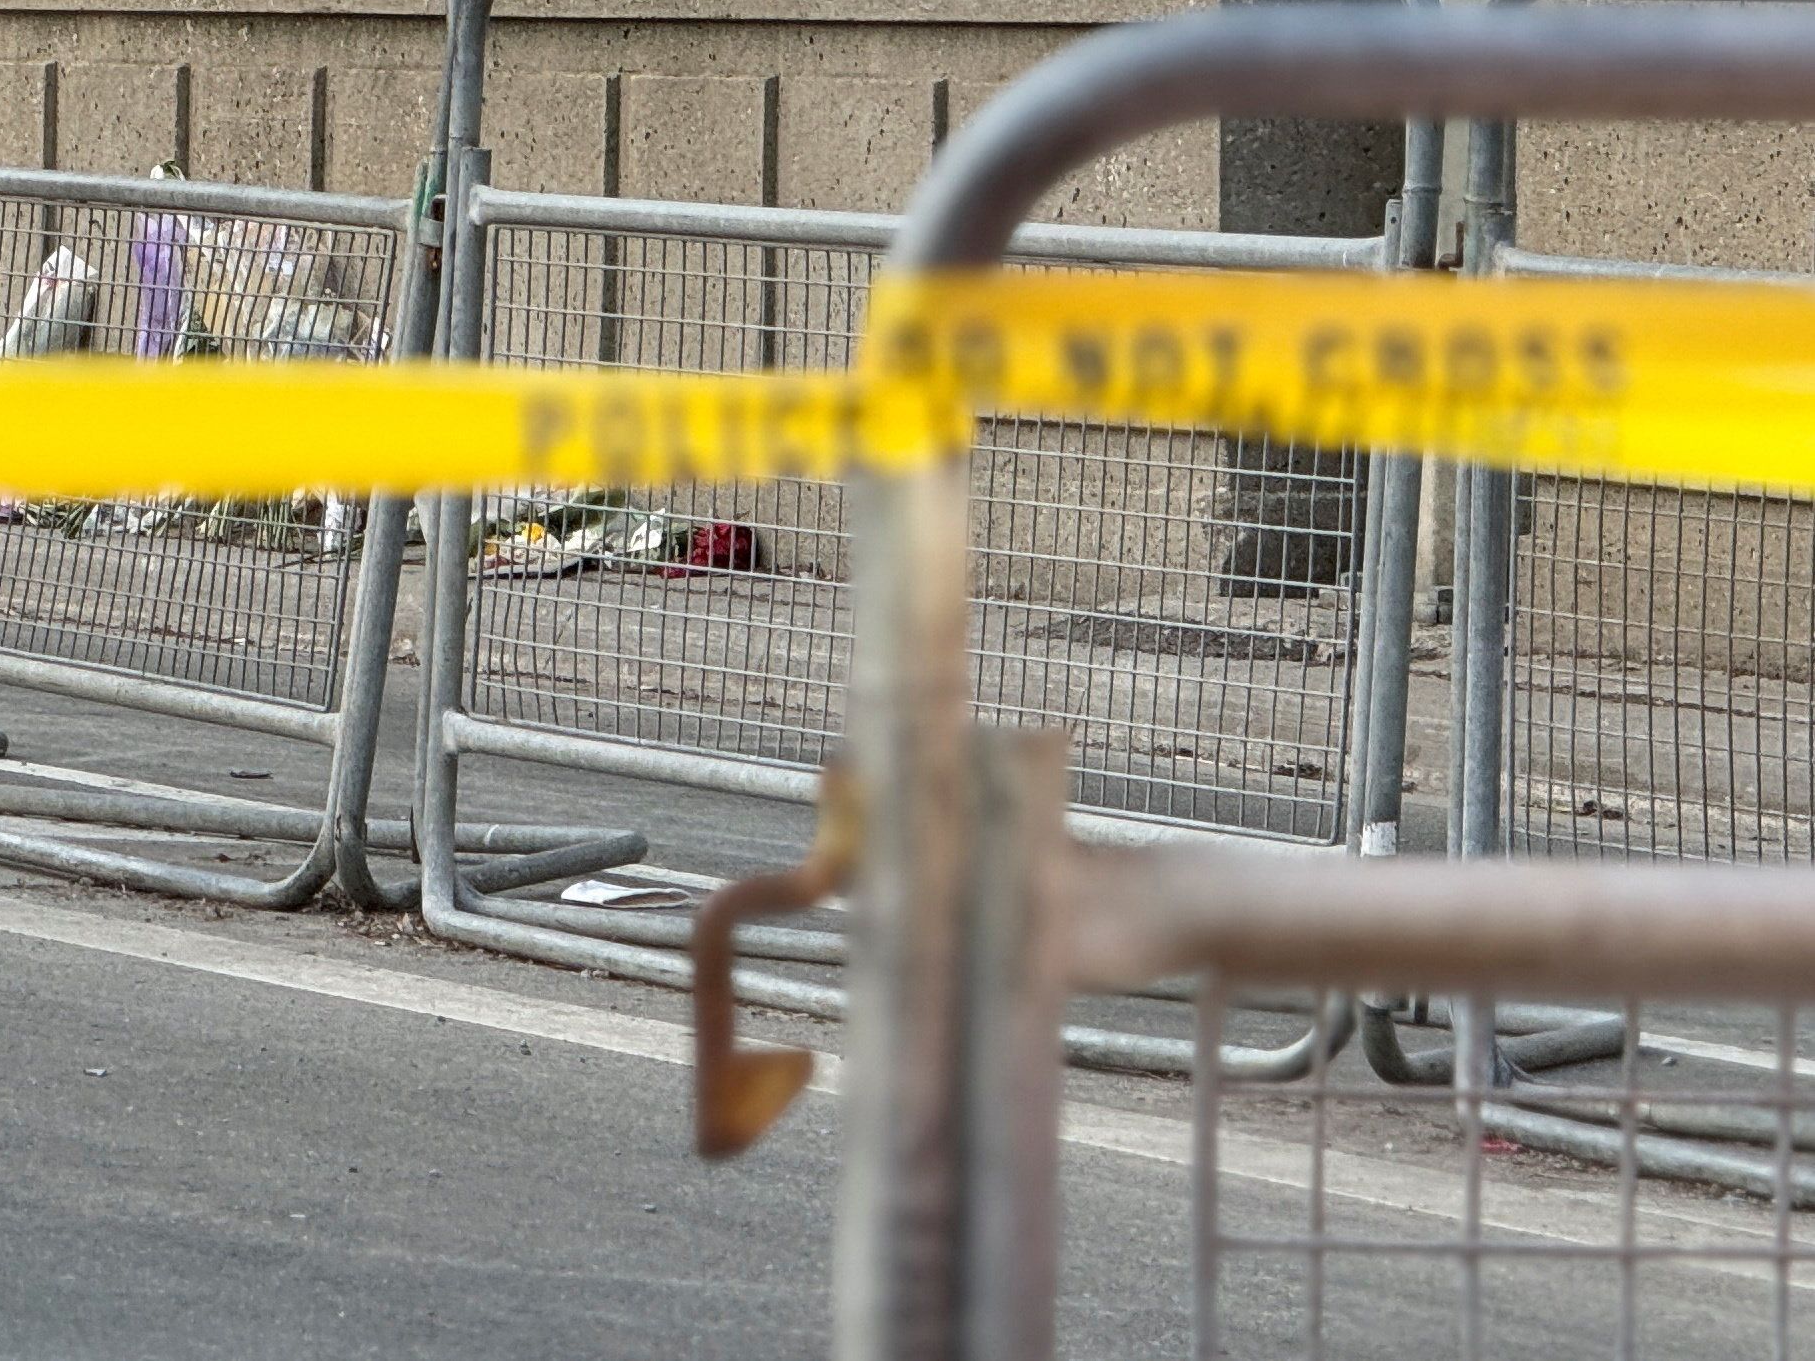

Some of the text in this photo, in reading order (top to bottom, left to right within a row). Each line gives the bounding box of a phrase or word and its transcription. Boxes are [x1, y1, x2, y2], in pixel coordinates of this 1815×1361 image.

[1066, 319, 1244, 392] NOT
[1304, 321, 1626, 395] CROSS
[522, 393, 870, 479] POLICE
